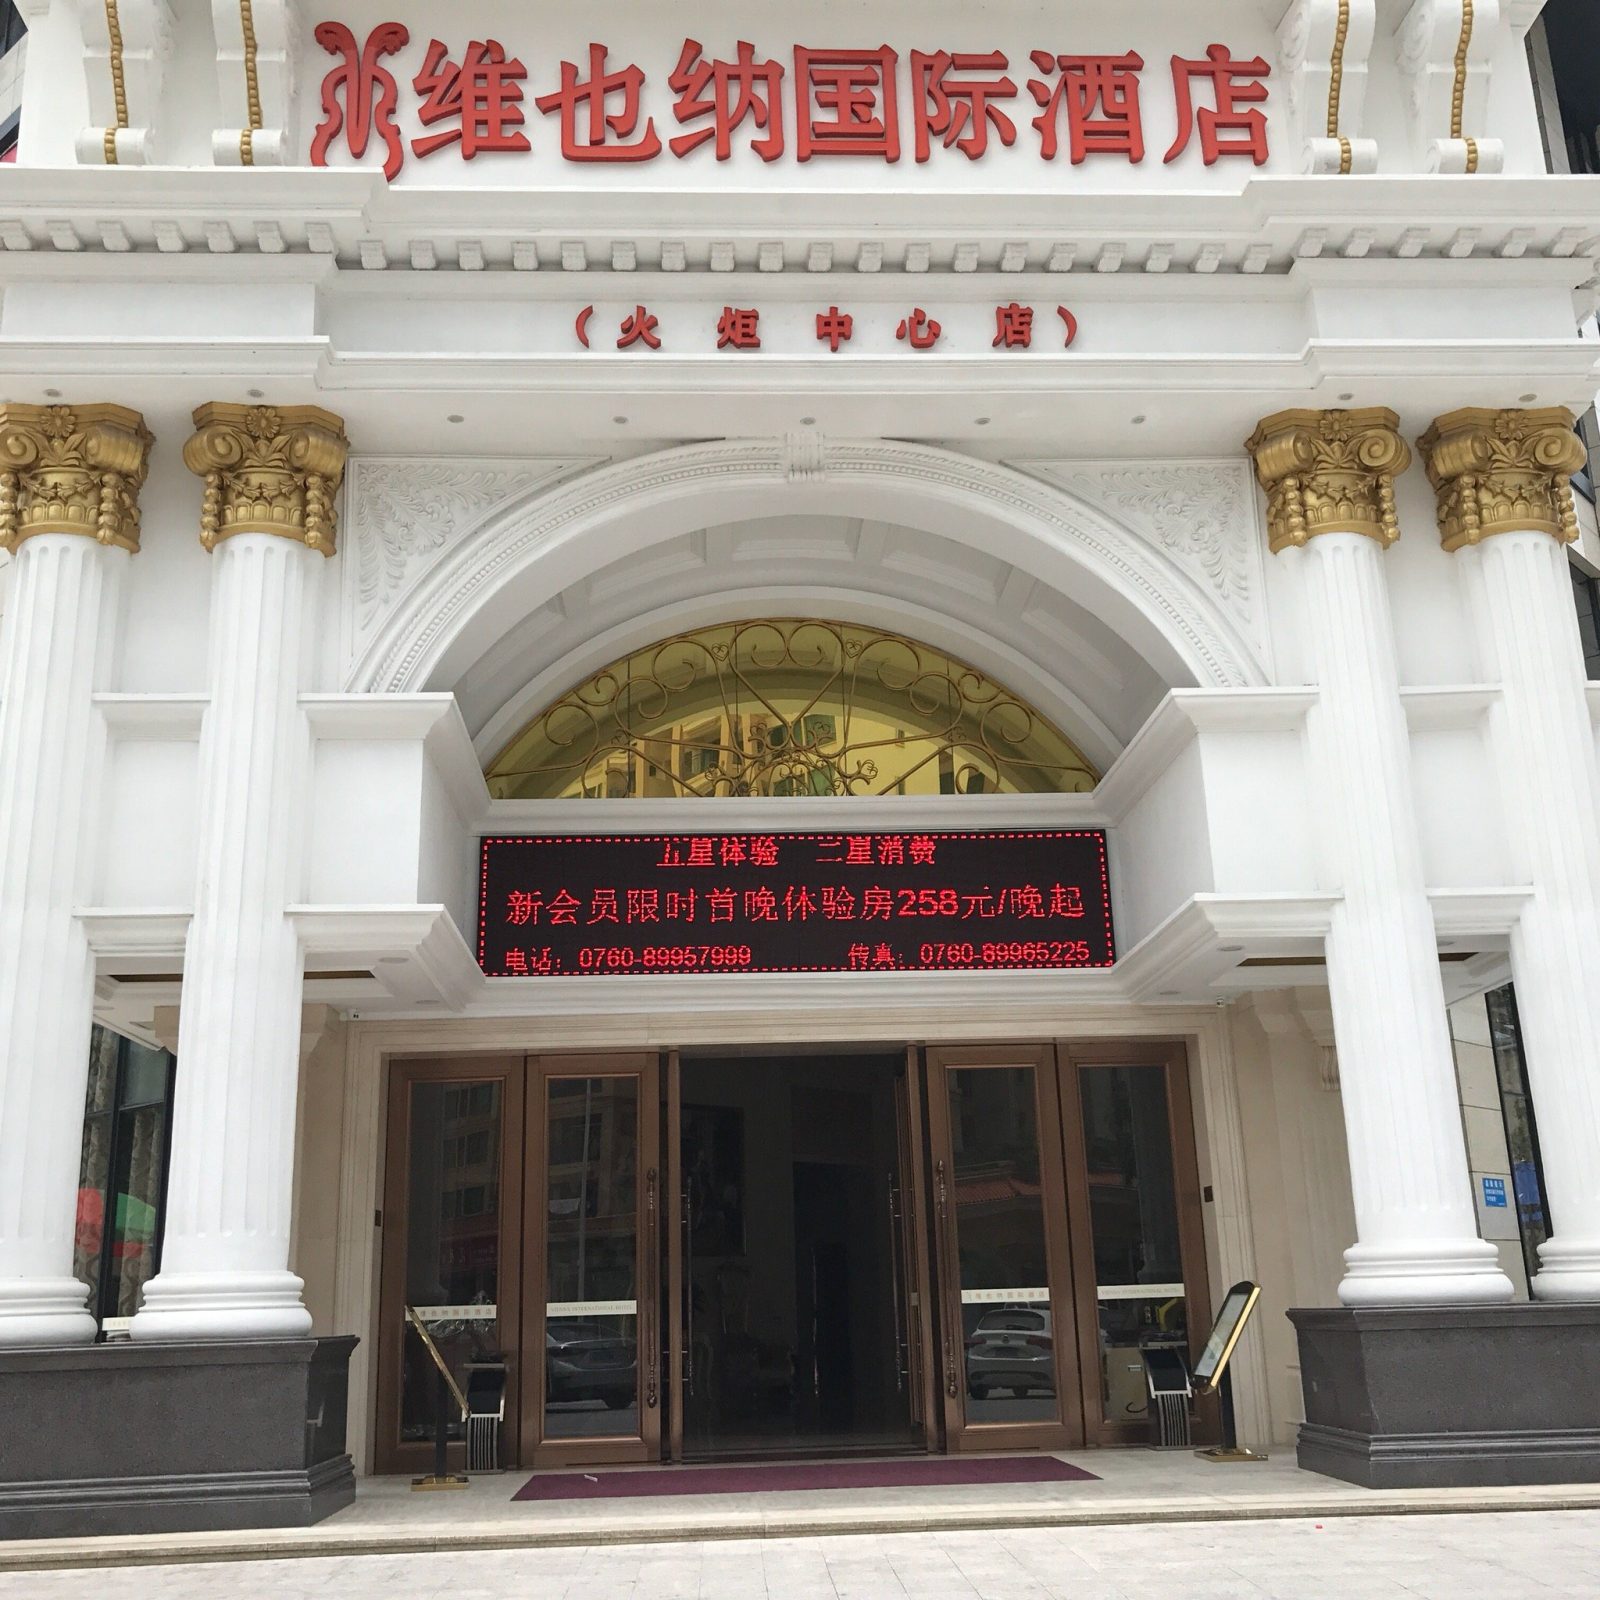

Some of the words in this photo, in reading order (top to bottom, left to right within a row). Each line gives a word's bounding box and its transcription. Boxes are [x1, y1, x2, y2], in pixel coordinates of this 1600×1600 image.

[411, 38, 1270, 165] 维也纳国际酒店
[576, 303, 1077, 350] （火炬中心店）
[506, 882, 1085, 926] 新会员限时首晚体验房258元/晚起
